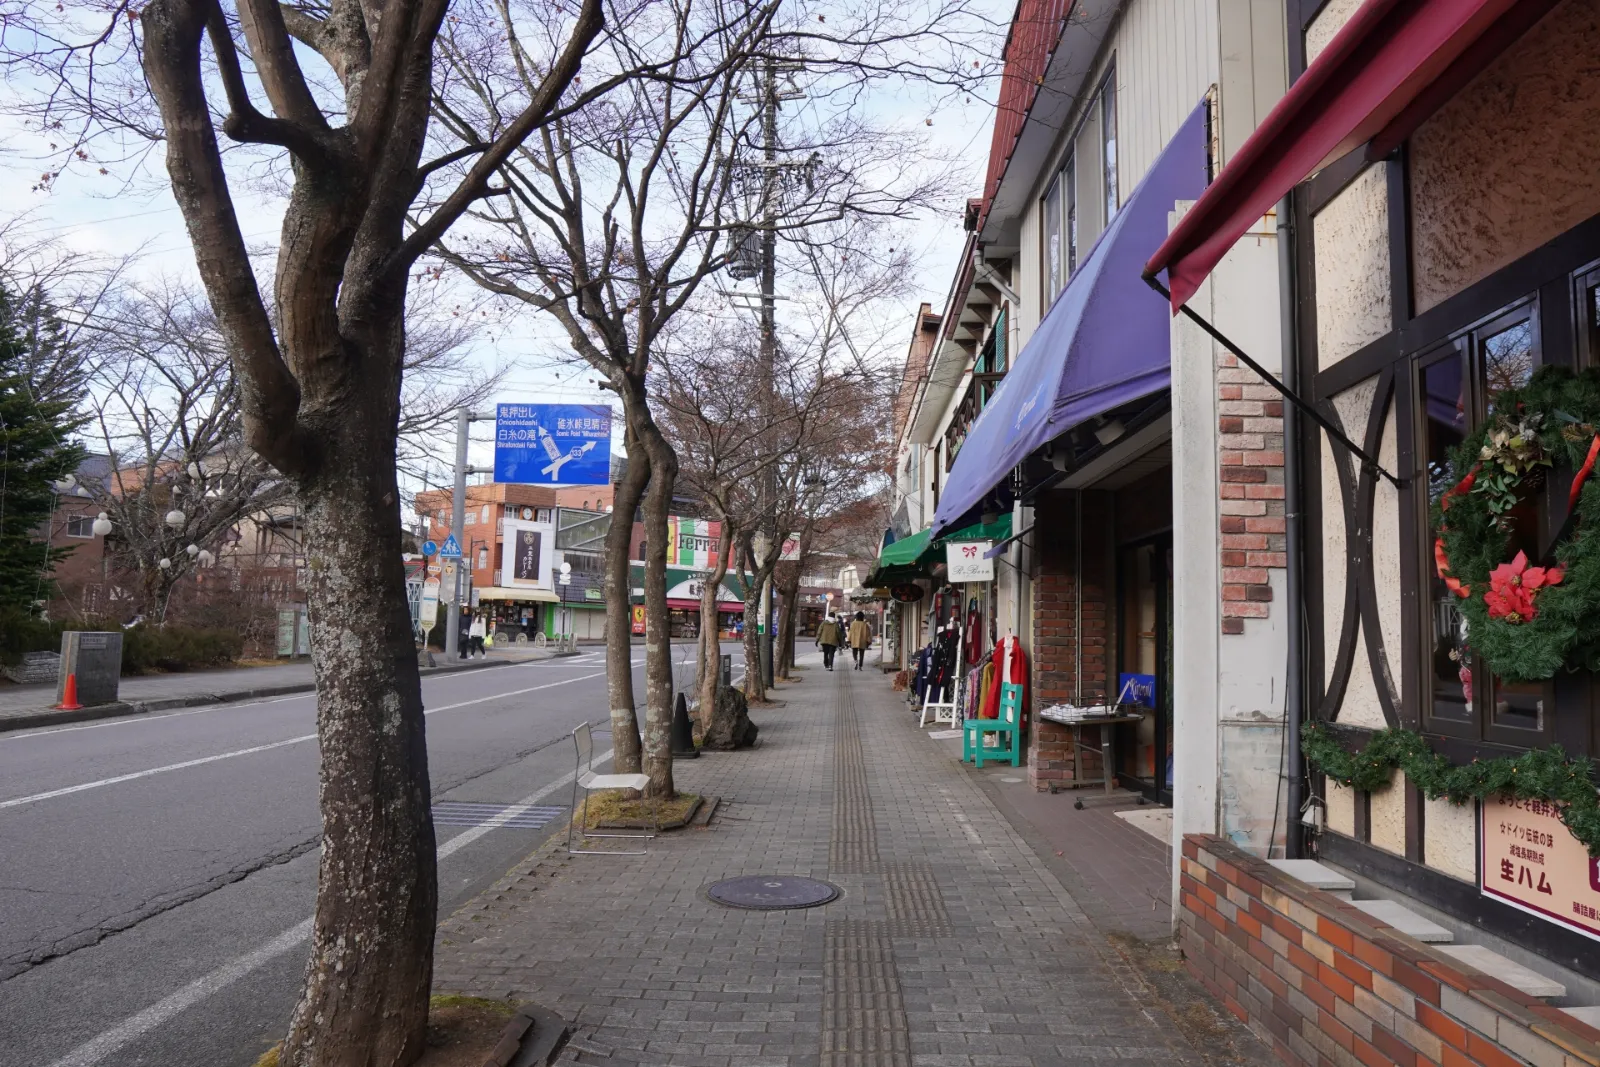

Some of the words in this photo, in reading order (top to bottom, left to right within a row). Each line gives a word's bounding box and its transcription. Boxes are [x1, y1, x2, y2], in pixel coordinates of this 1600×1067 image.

[499, 406, 537, 418] 鬼押出し
[498, 429, 537, 441] 白糸の滝
[678, 533, 720, 552] Ferra
[1509, 844, 1545, 866] 減塩長期熟成
[1500, 858, 1553, 896] 生ハム
